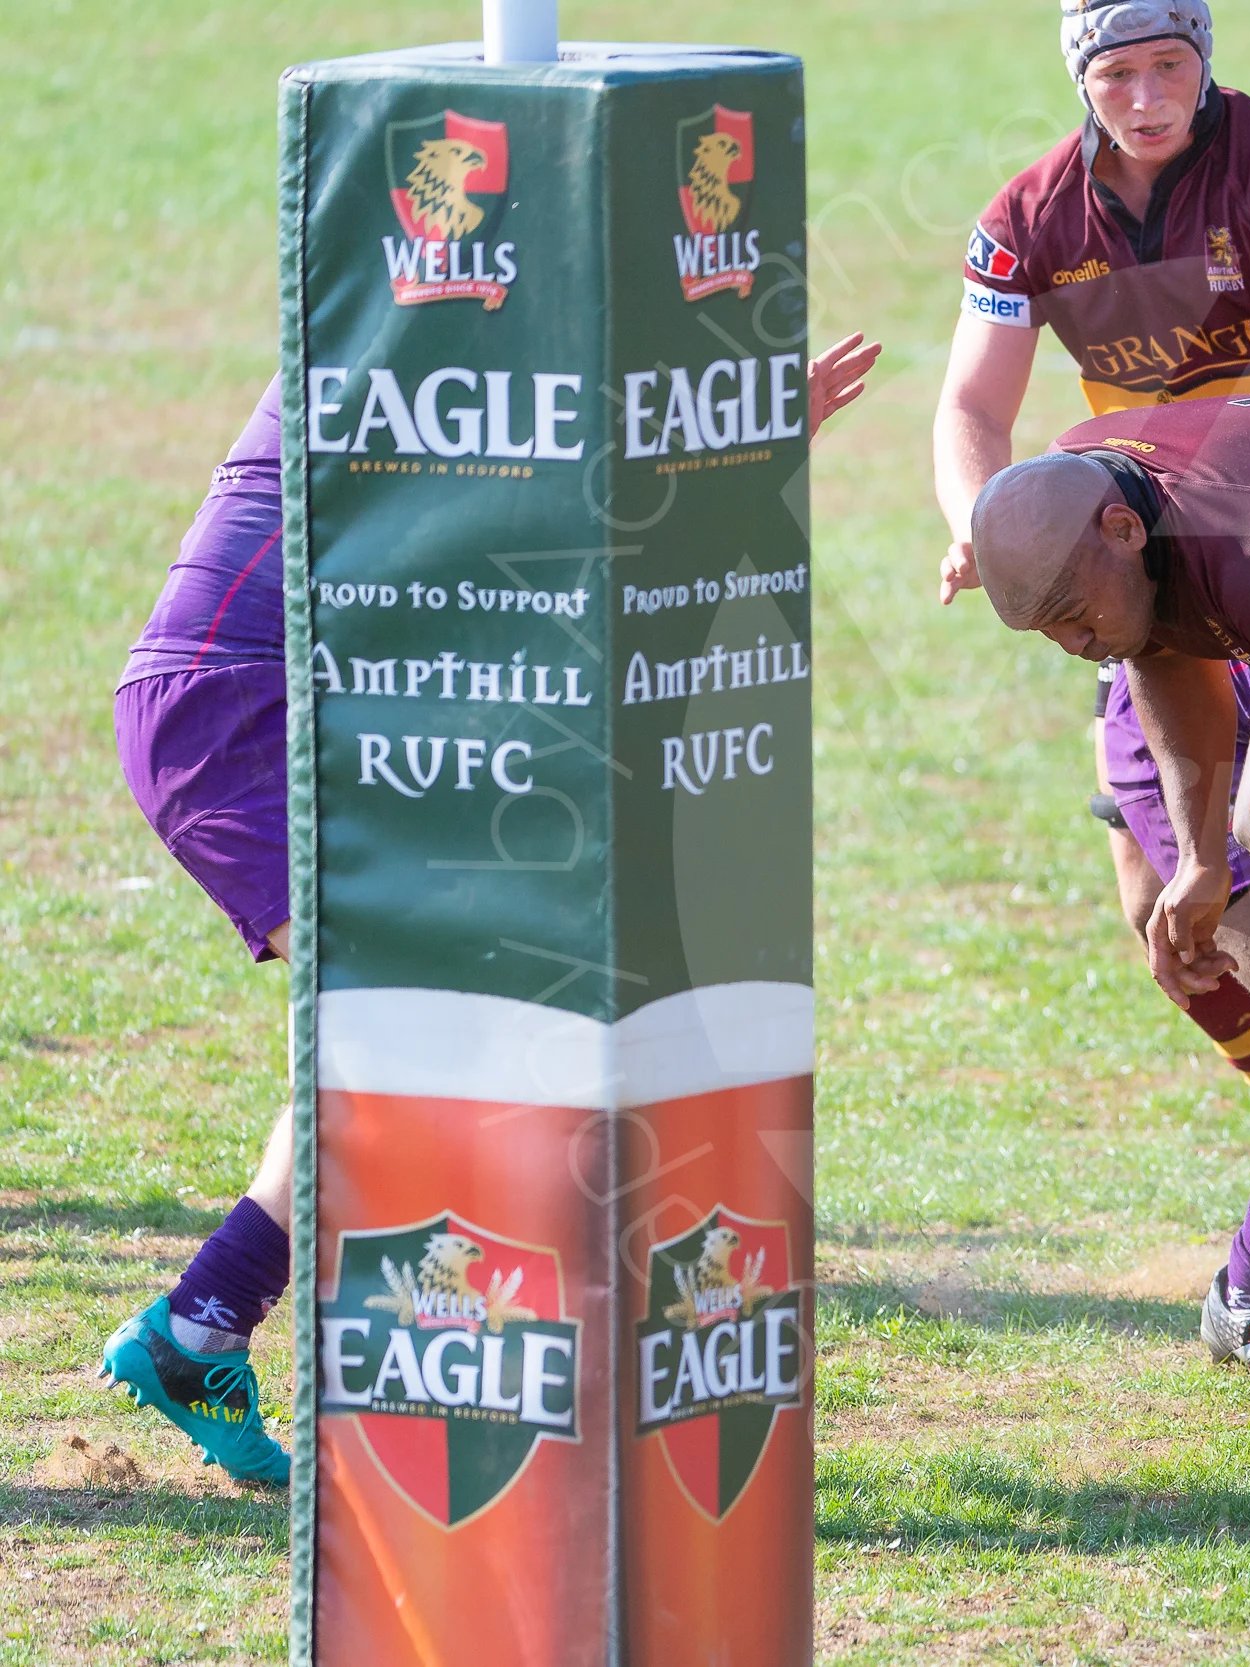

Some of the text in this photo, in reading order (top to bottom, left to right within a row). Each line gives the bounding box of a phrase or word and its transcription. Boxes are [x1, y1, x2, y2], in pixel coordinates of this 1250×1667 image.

[382, 235, 518, 285] WELLS
[673, 229, 760, 278] WELLS
[1210, 279, 1245, 292] RUGBY
[308, 366, 585, 461] EAGLE
[624, 353, 802, 460] EAGLE
[350, 460, 534, 479] BREWED IN BEDFORD
[356, 733, 534, 798] RUFC
[661, 722, 774, 796] RUFC
[411, 1288, 488, 1322] WELLS
[693, 1283, 743, 1314] WELLS
[320, 1317, 574, 1427] EAGLE
[639, 1307, 799, 1425] EAGLE
